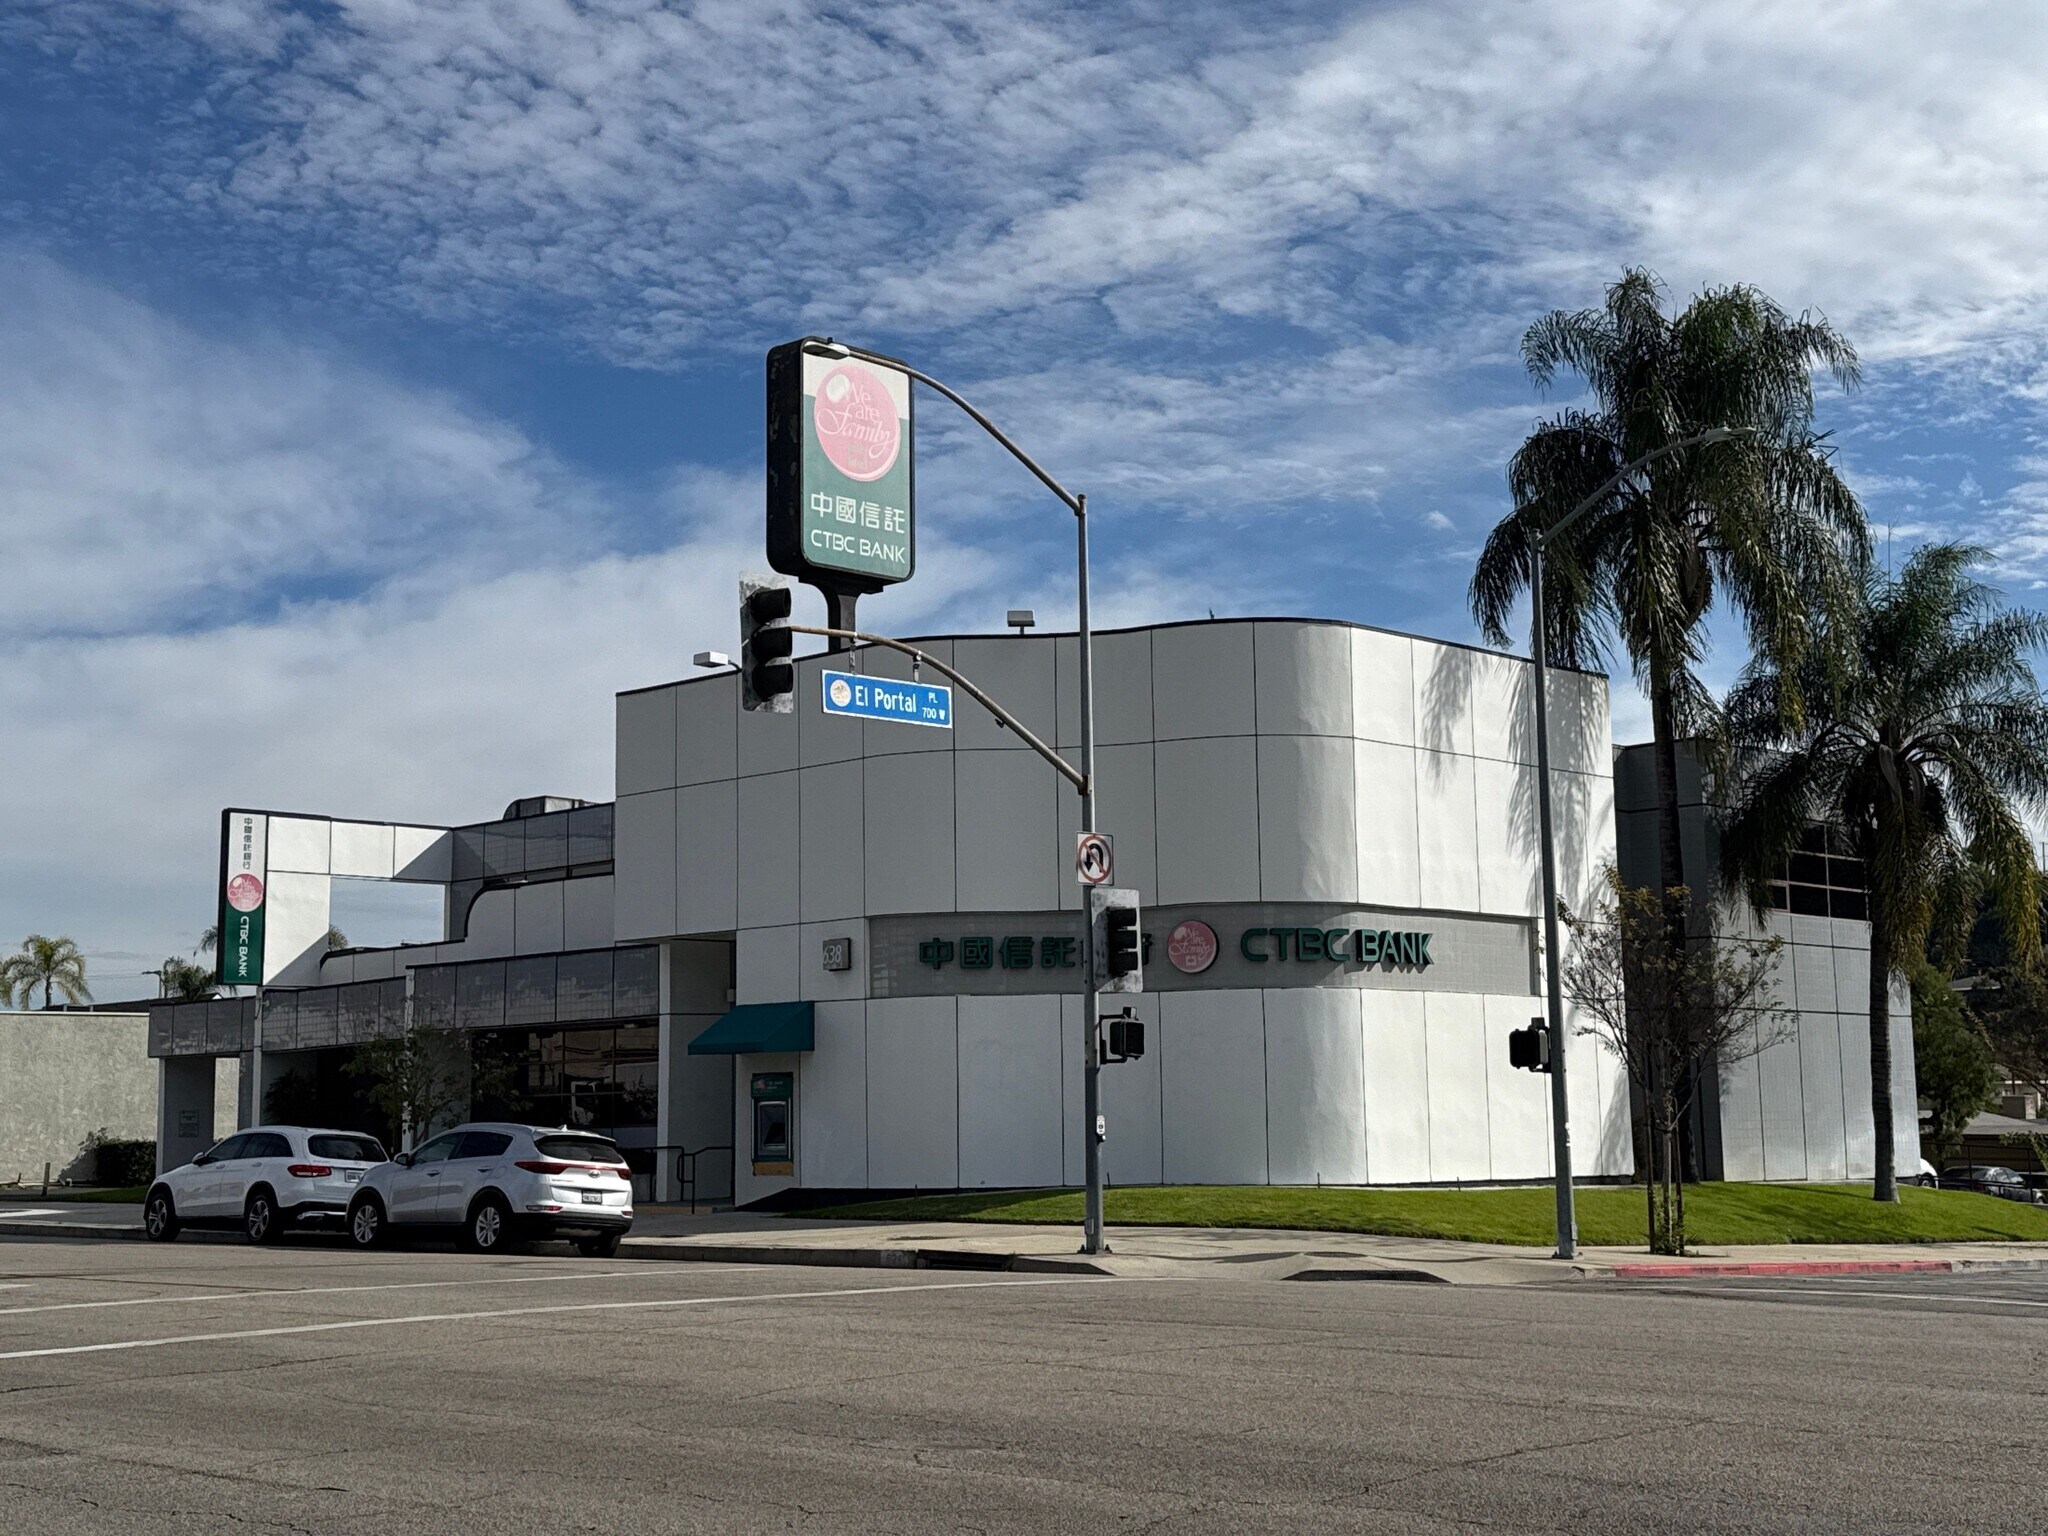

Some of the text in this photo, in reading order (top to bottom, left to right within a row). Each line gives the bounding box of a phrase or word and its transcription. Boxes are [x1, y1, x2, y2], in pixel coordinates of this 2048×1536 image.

[843, 381, 871, 404] We
[816, 402, 898, 458] Family
[810, 491, 905, 534] 中國信託
[811, 529, 906, 564] CTBC BANK
[855, 685, 917, 713] El Portal
[922, 707, 937, 720] 700
[928, 692, 938, 704] PL
[238, 915, 250, 978] CTBC BANK
[823, 944, 842, 964] 638
[919, 935, 1152, 970] 中國信託
[1240, 927, 1434, 965] CTBC BANK
